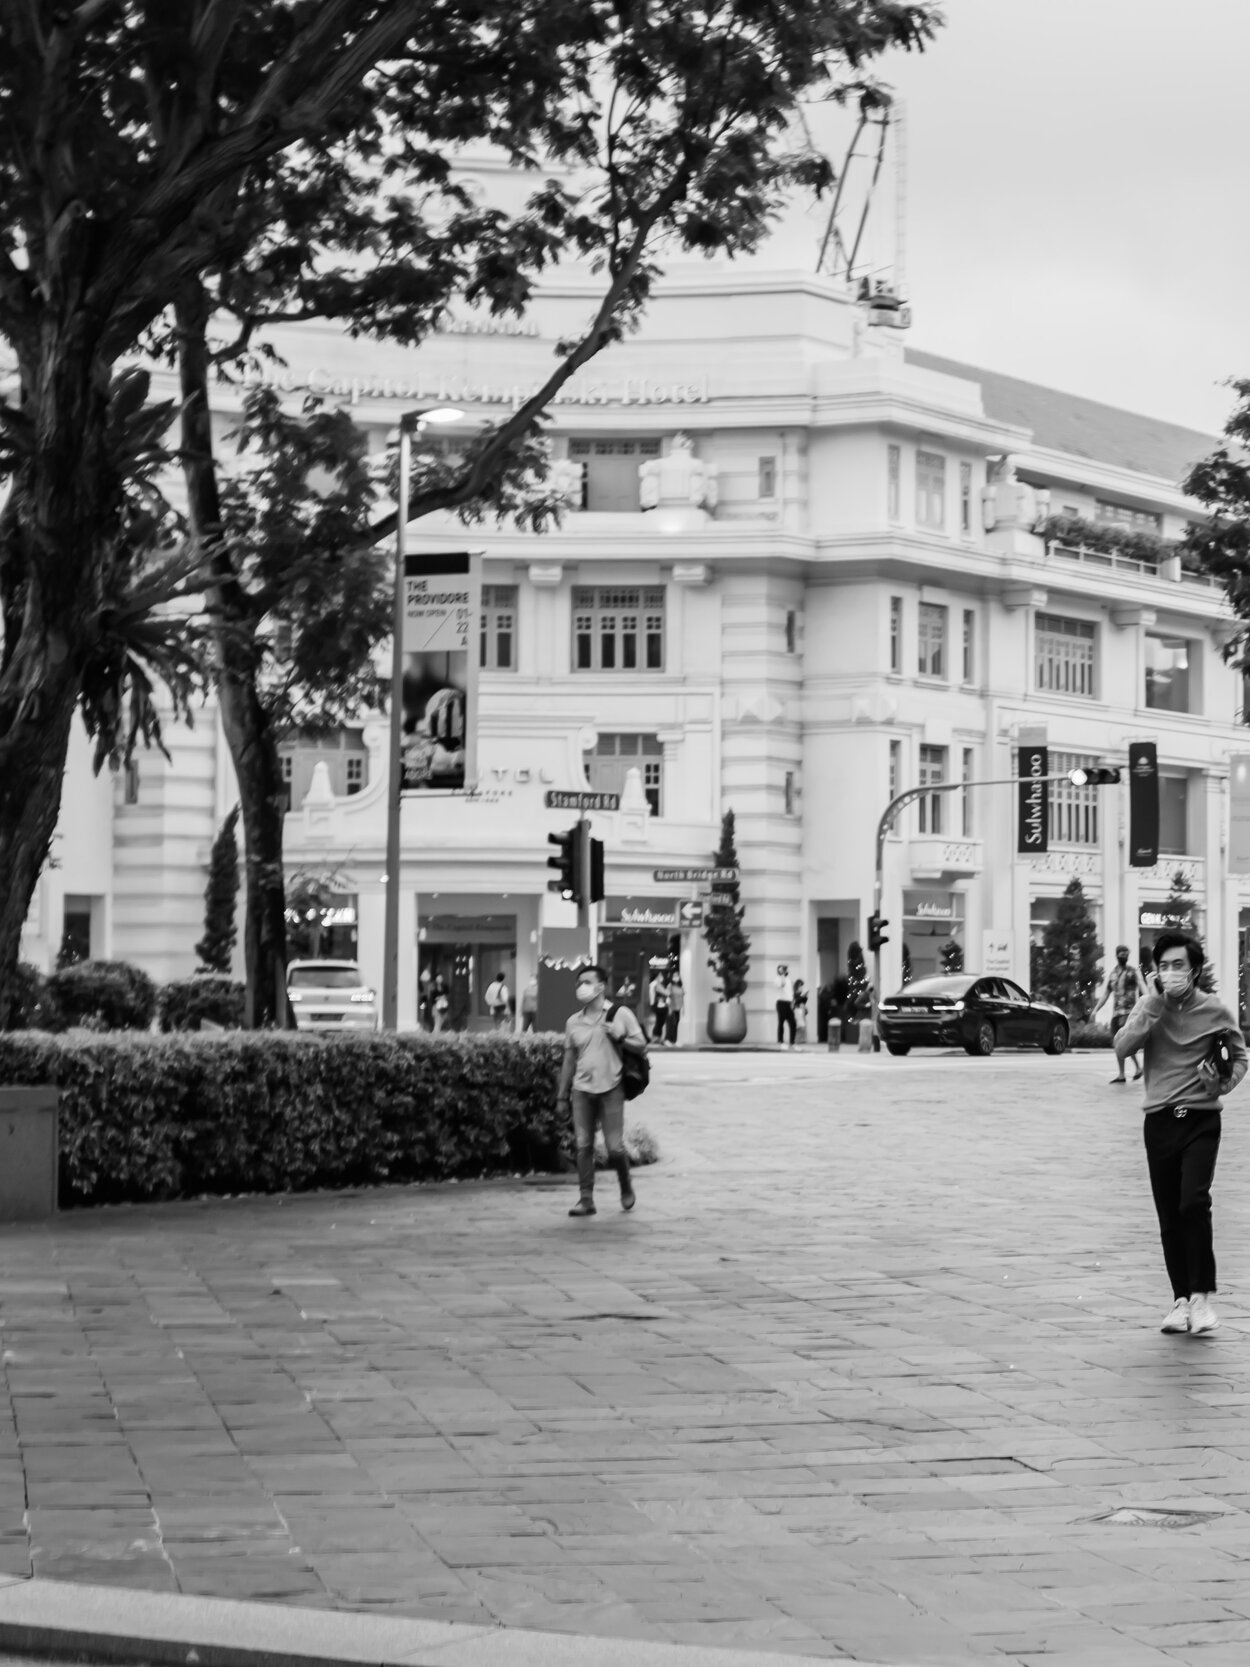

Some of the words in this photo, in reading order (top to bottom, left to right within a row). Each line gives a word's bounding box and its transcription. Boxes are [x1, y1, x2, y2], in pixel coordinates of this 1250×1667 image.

[308, 368, 426, 404] Capitol
[437, 376, 610, 410] Kempski
[621, 375, 710, 404] Hotel
[407, 580, 428, 592] THE
[407, 592, 469, 606] PROVIDORE
[550, 792, 600, 808] Stamford
[603, 794, 617, 809] Rd
[657, 870, 684, 880] North
[687, 870, 718, 881] Bridge
[721, 870, 733, 879] Rd
